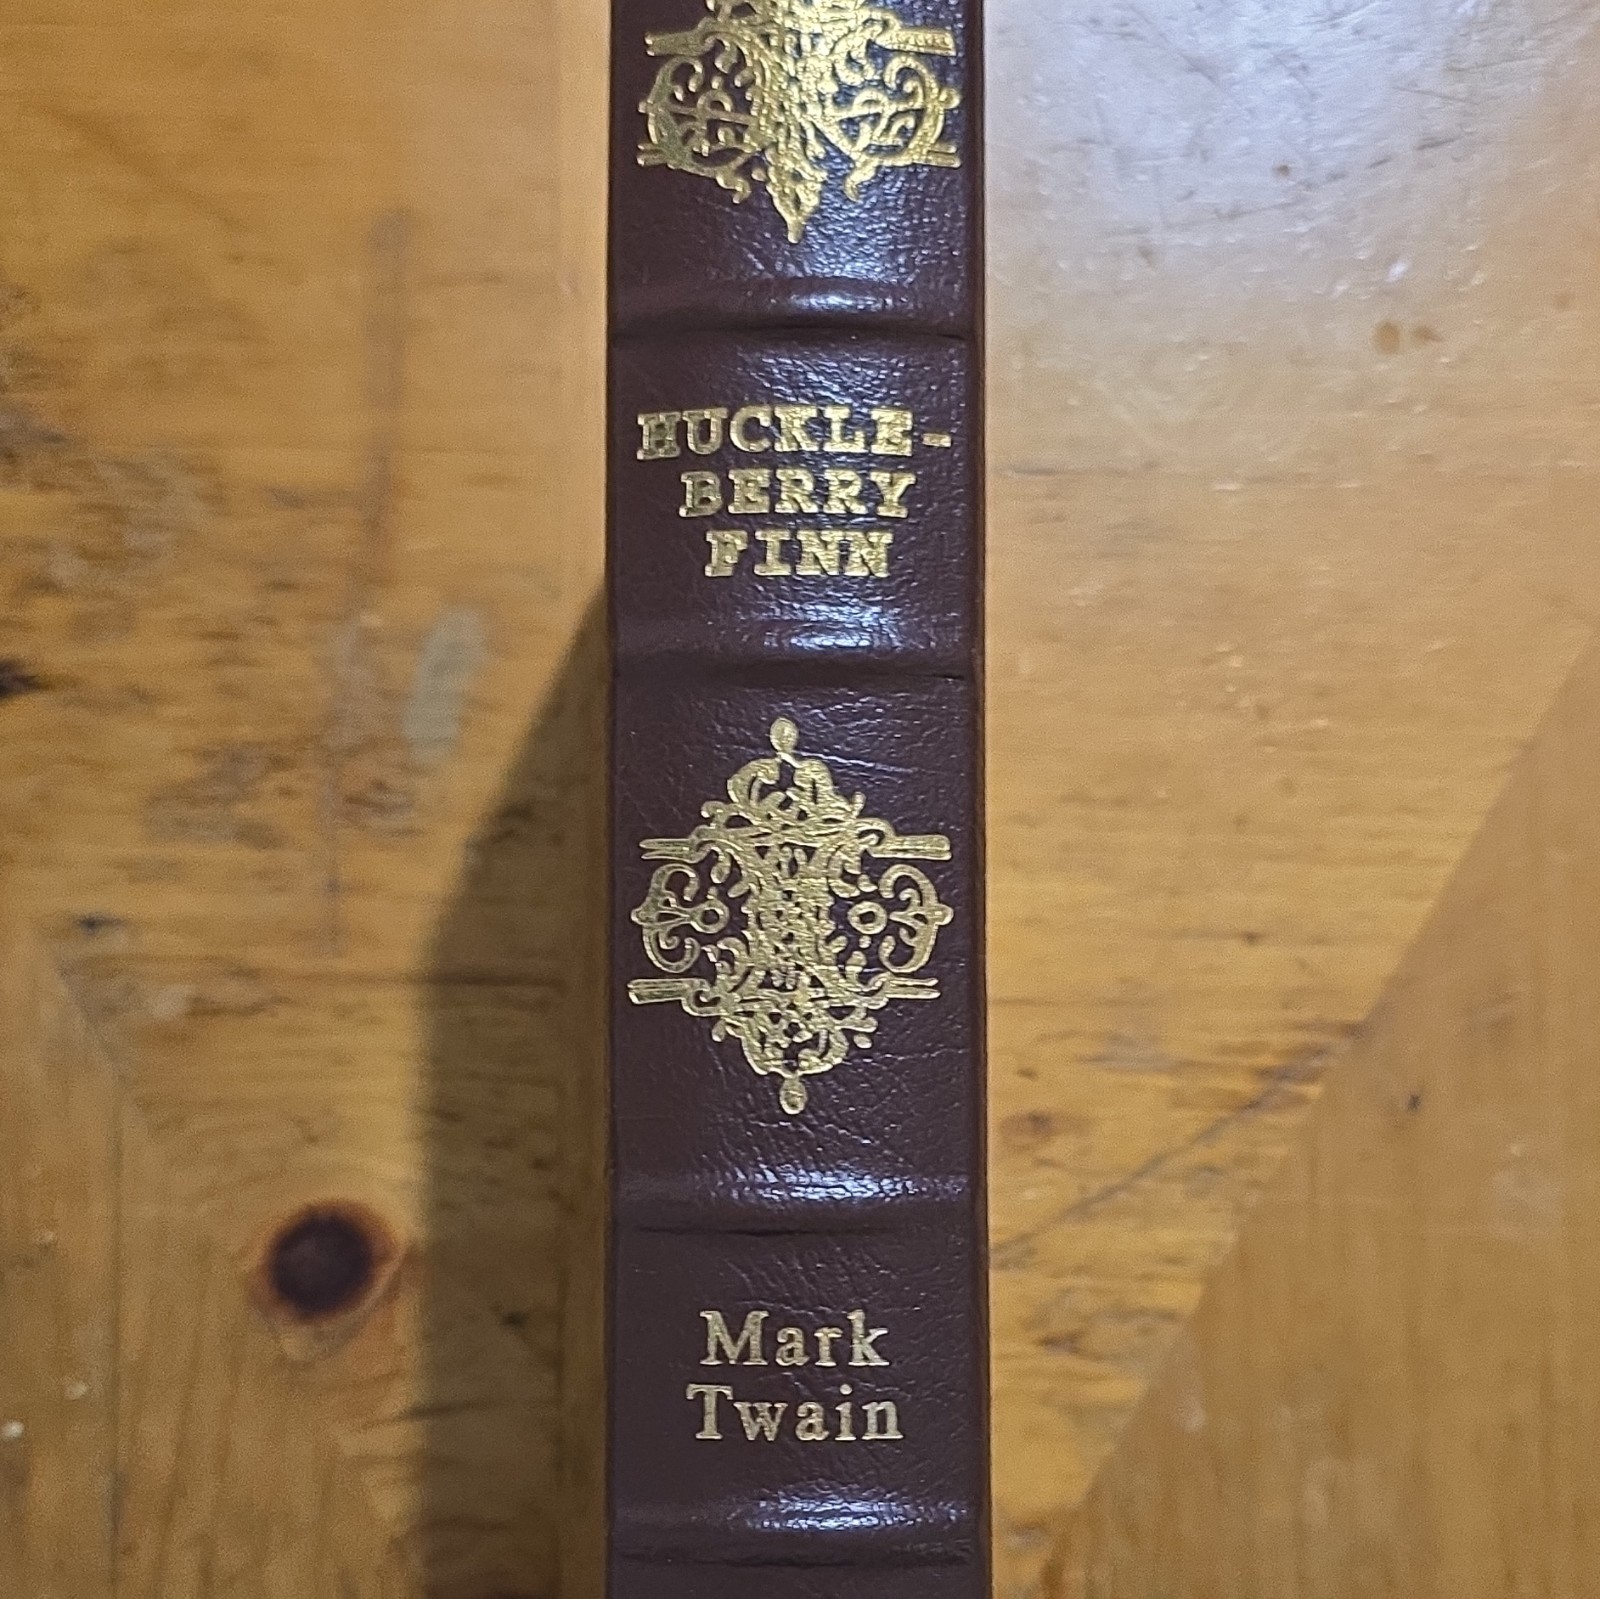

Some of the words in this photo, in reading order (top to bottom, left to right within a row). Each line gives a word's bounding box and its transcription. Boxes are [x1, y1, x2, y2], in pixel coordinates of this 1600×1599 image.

[636, 405, 952, 461] HUCKLE-
[678, 467, 917, 518] BERRY
[704, 529, 894, 578] FINN
[699, 1308, 890, 1367] Mark
[685, 1383, 904, 1442] Twain
